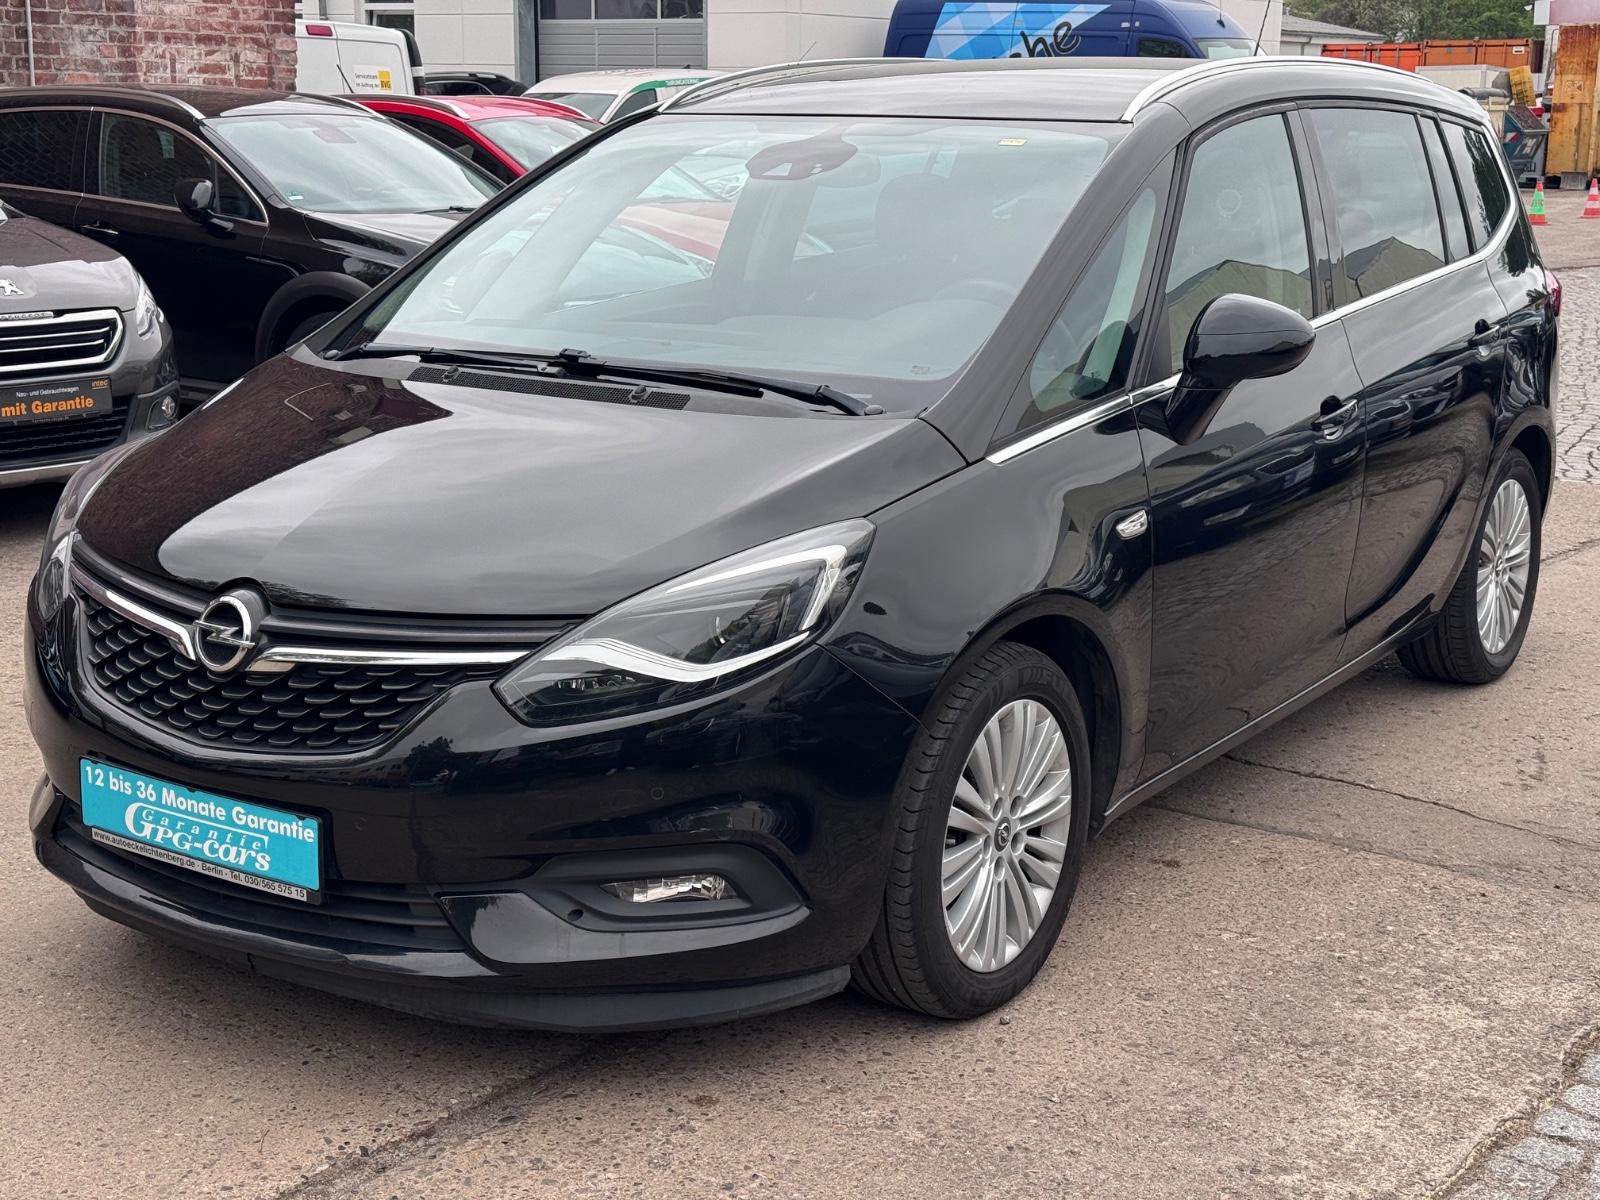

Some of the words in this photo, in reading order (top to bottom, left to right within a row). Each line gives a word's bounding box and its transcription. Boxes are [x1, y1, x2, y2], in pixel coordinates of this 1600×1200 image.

[380, 80, 392, 88] BVG
[0, 313, 49, 321] PEUGEOT
[40, 386, 79, 396] Gebrauchtwagen
[1, 402, 27, 417] mit
[31, 395, 94, 415] Garantie
[85, 766, 105, 787] 12
[109, 771, 132, 795] bis
[136, 780, 156, 802] 36
[162, 787, 226, 821] Monate
[232, 806, 315, 843] Garantie
[93, 830, 196, 868] www.autoeckelichtenberg.de
[201, 862, 224, 877] Berlin
[230, 870, 243, 882] Tel.
[244, 875, 276, 892] 030/565
[277, 883, 293, 895] 575
[294, 888, 305, 898] 15
